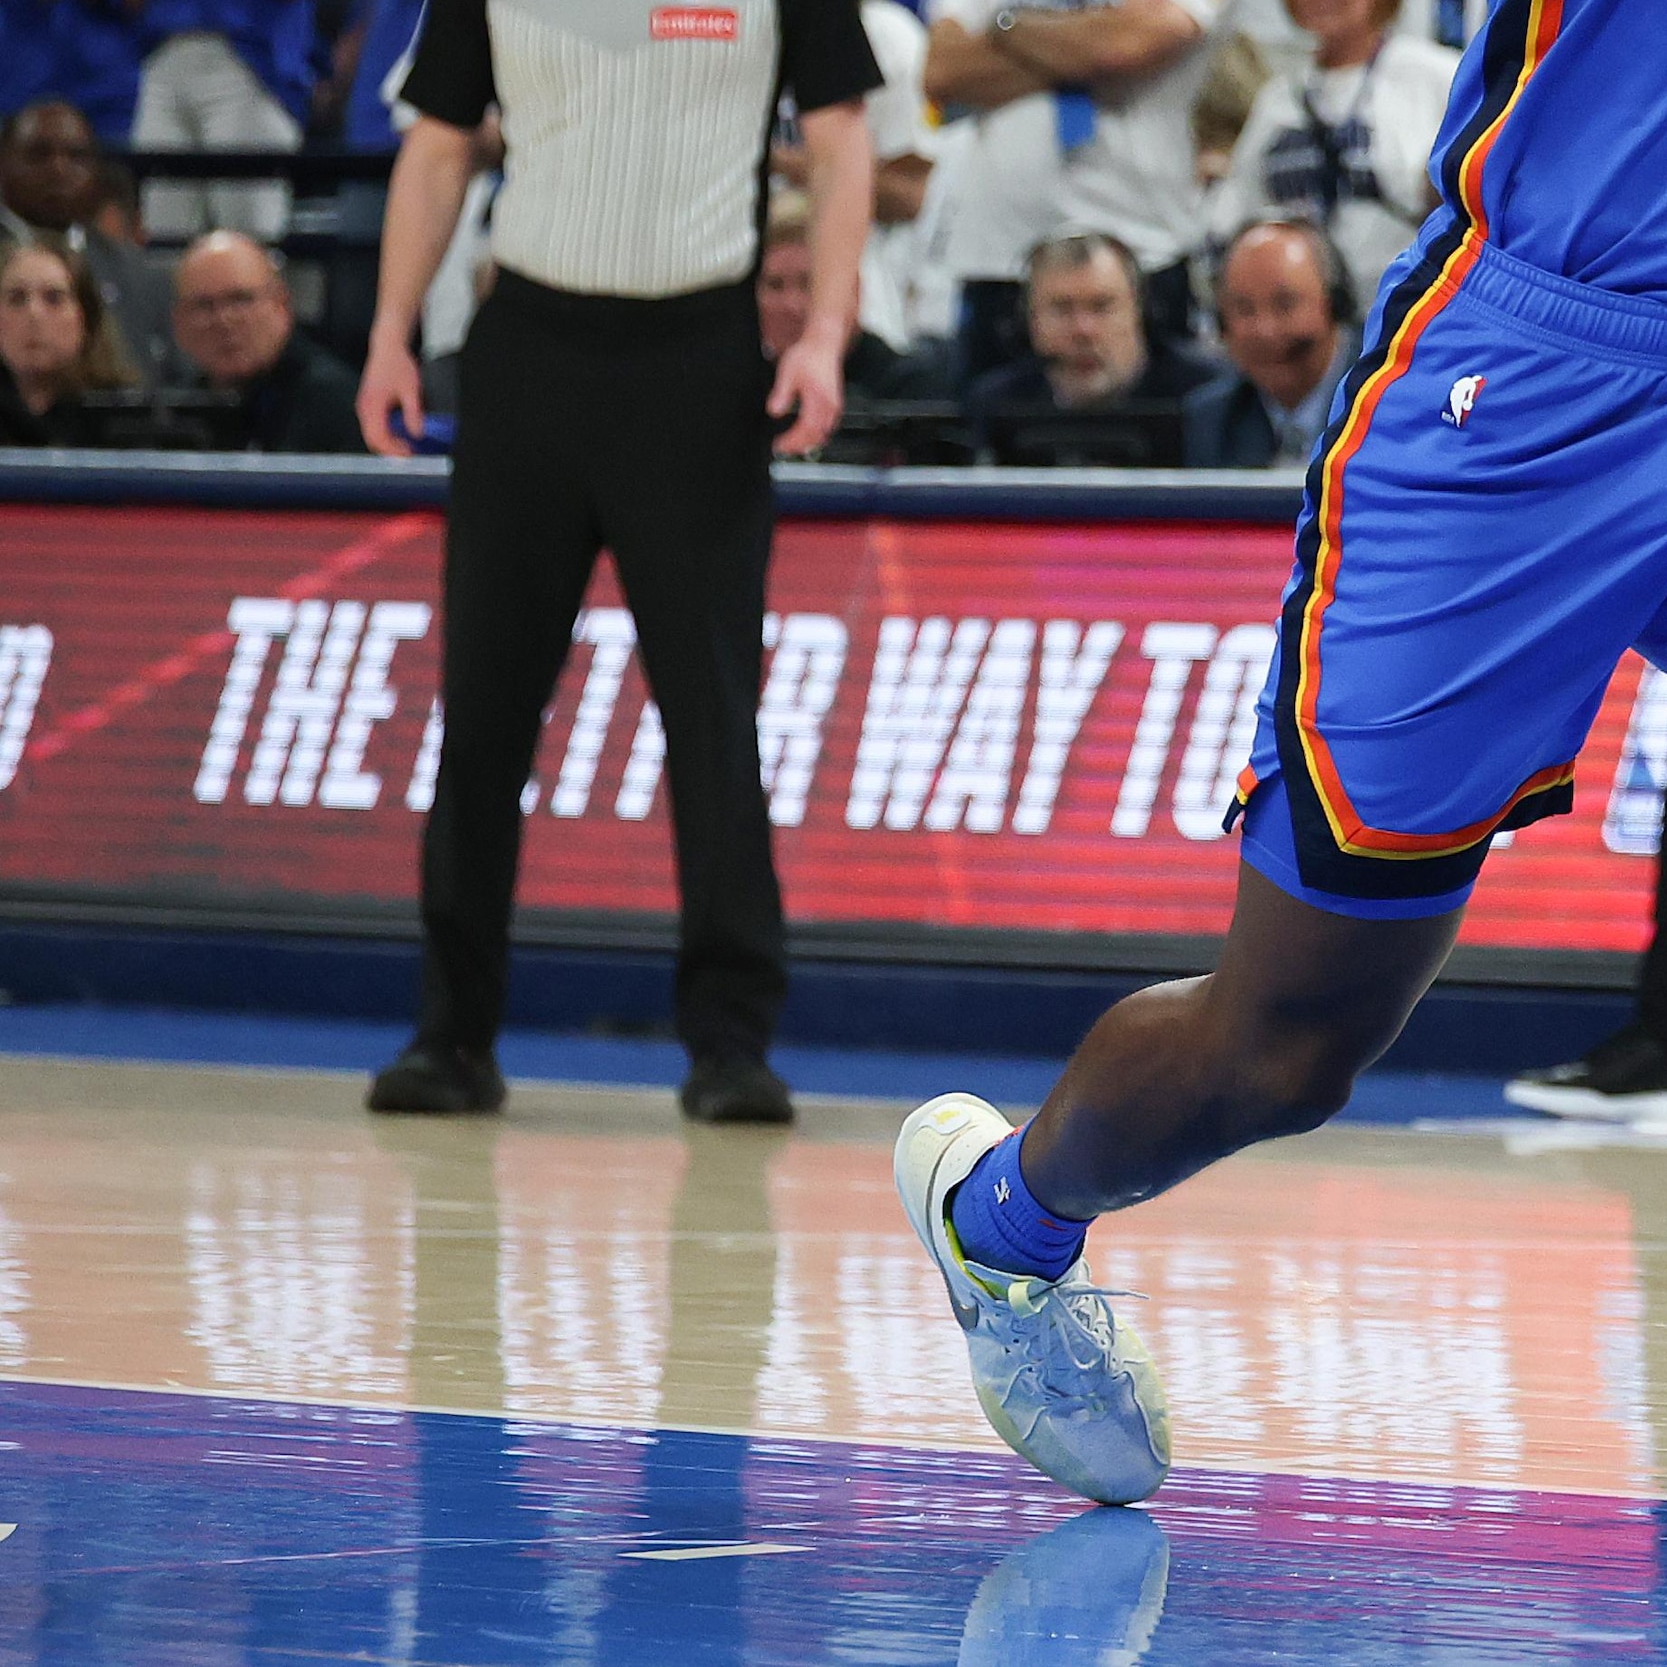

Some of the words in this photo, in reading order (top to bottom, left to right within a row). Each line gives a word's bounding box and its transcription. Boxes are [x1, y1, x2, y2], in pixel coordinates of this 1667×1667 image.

[192, 597, 432, 811] THE
[846, 616, 1124, 837] WAY
[1110, 620, 1279, 841] TO
